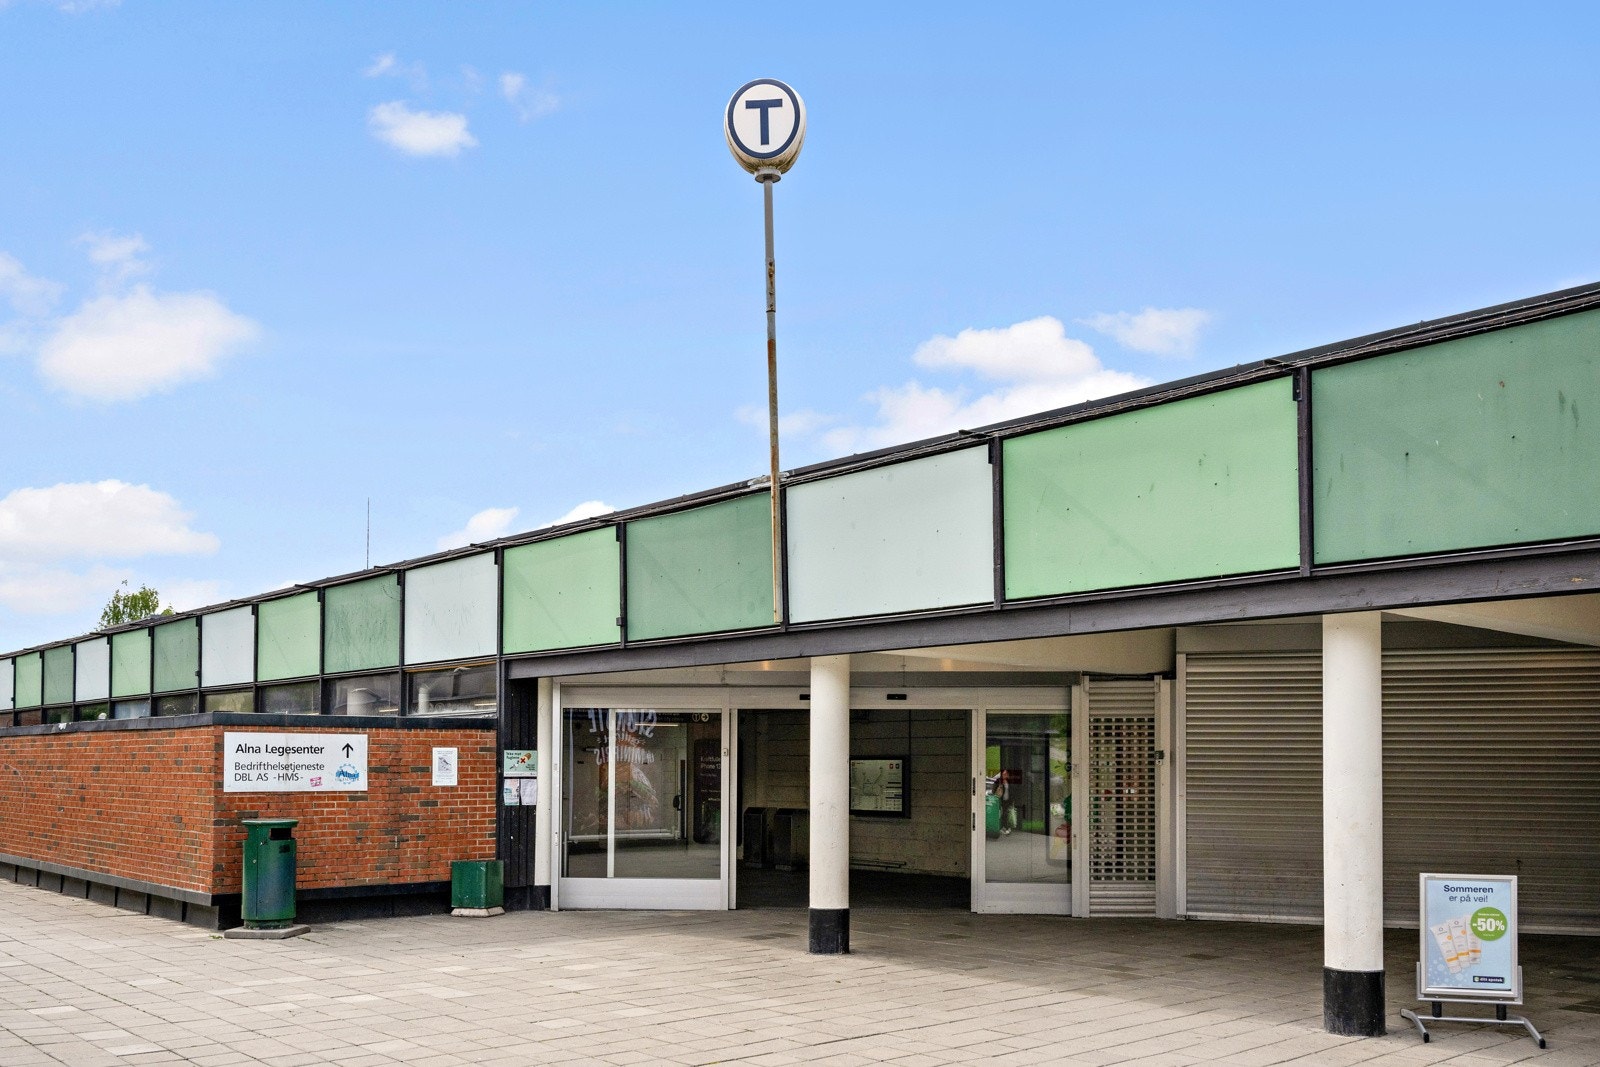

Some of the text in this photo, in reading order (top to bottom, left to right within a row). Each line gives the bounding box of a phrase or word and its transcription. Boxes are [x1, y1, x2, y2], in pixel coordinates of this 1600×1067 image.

[745, 98, 783, 145] T
[235, 743, 325, 756] Alna Legesenter
[234, 762, 325, 772] Bedrifthelsetjeneste
[234, 773, 304, 781] DBL AS -HMS-
[1443, 884, 1494, 893] Sommeren
[1460, 894, 1471, 903] på
[1472, 918, 1505, 932] -50%
